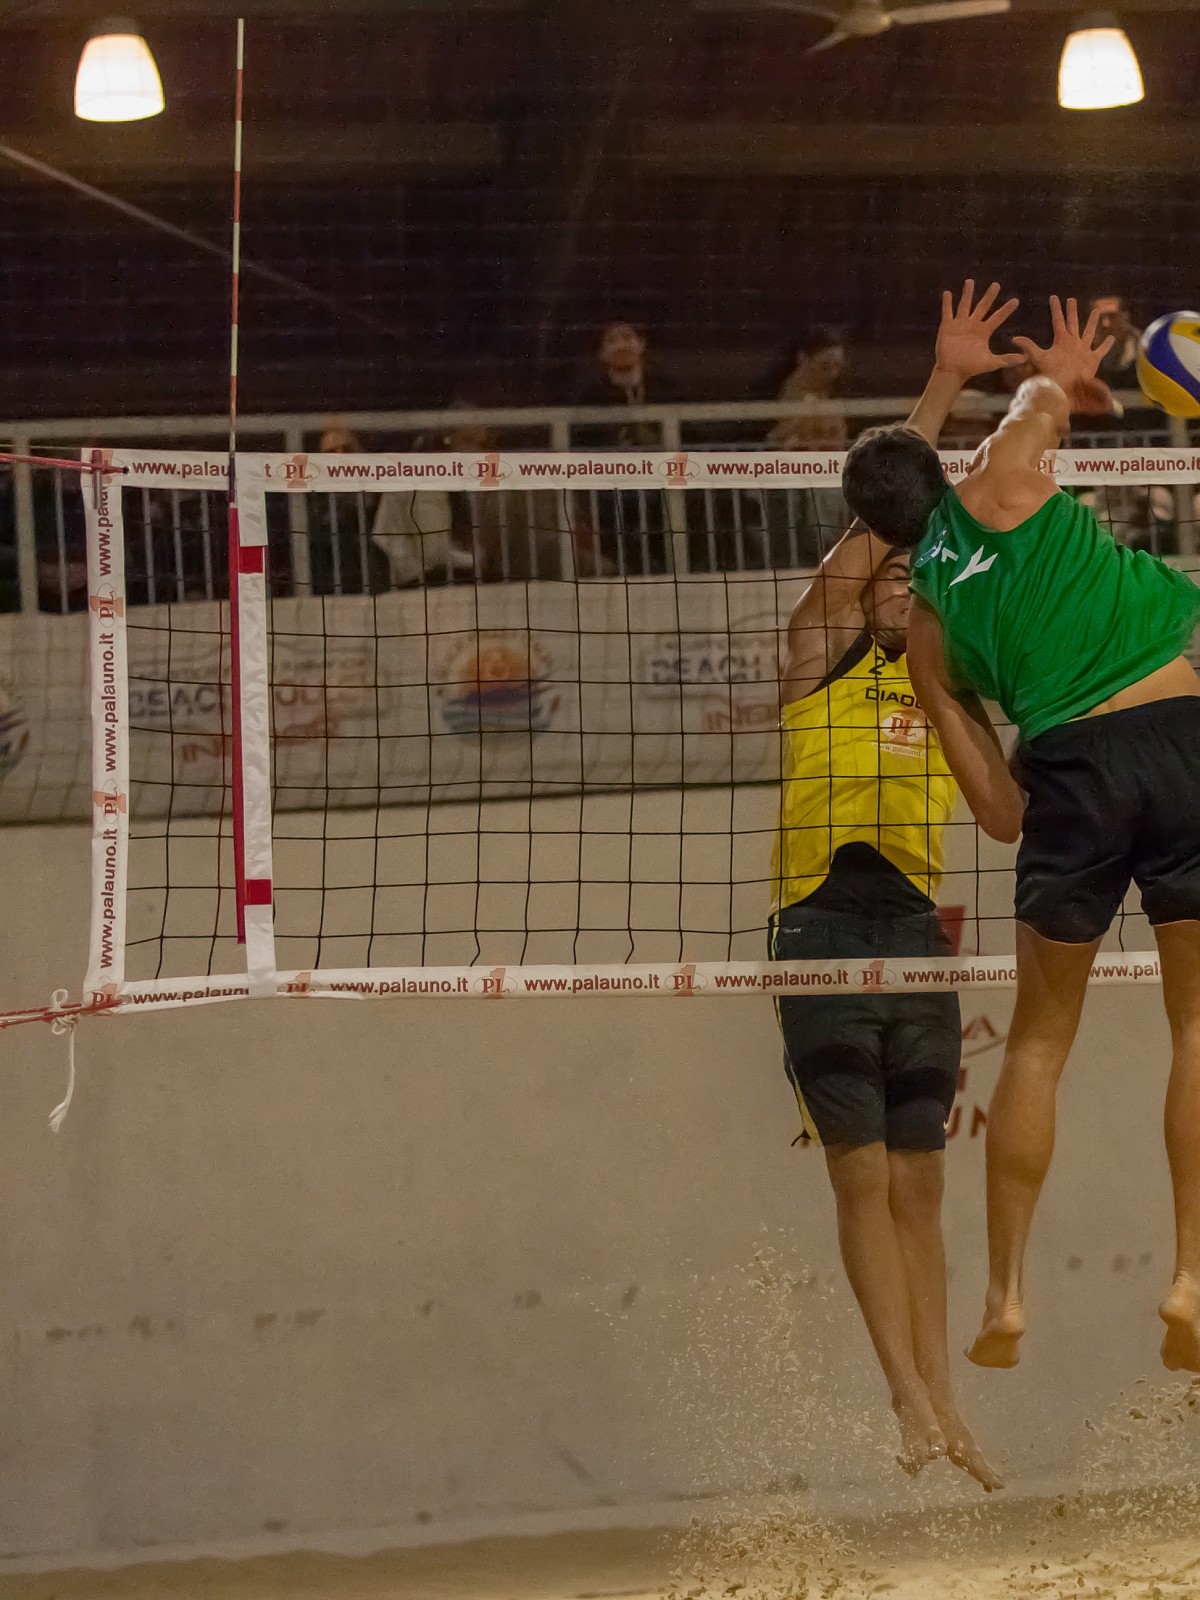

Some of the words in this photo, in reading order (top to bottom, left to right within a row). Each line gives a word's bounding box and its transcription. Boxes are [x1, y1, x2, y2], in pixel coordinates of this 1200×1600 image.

[327, 461, 463, 480] www.palauno.it
[519, 460, 653, 480] www.palauno.it
[707, 459, 839, 478] www.palauno.it
[867, 656, 886, 676] 2
[99, 632, 118, 773] www.palauno.it
[865, 687, 921, 709] DIAD
[100, 828, 118, 970] www.palauno.it
[133, 986, 249, 1004] www.palaun
[331, 976, 468, 996] www.palauno.it
[524, 974, 659, 994] www.palauno.it
[715, 969, 848, 989] www.palauno.it
[903, 966, 1016, 985] www.palauno
[1089, 960, 1160, 980] www.pal
